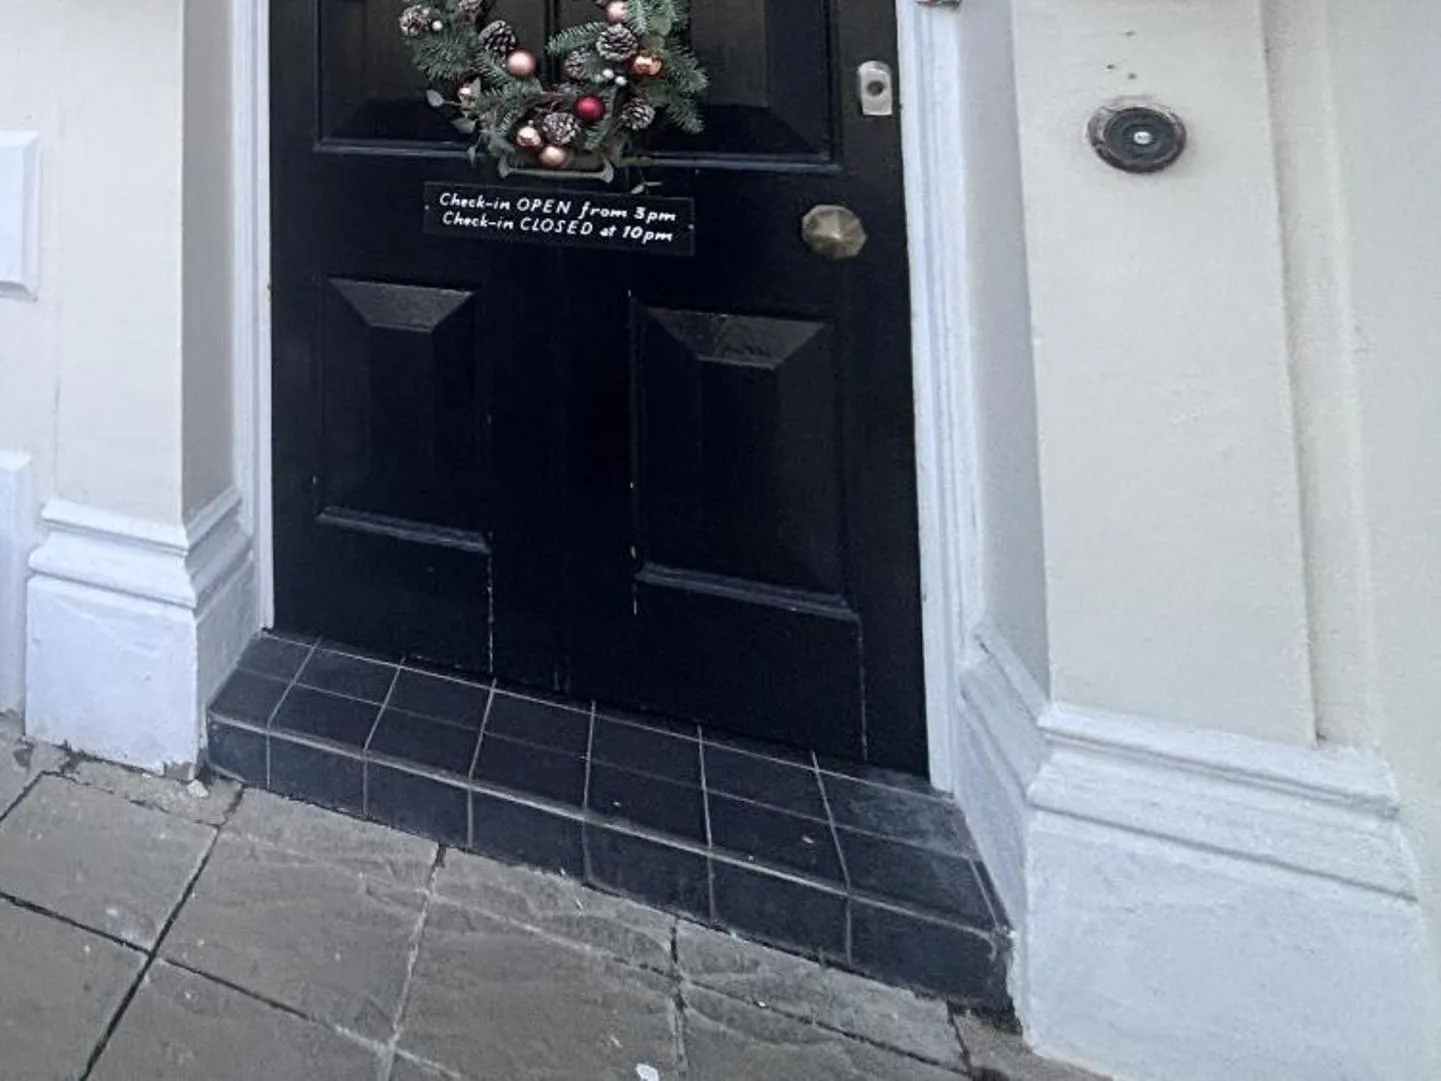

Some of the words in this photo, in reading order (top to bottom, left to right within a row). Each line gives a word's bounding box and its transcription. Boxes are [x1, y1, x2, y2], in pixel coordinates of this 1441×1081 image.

[440, 193, 510, 212] Check-in
[517, 197, 572, 215] OPEN
[579, 201, 628, 219] from
[634, 206, 676, 225] 3pm
[442, 211, 513, 230] Check-in
[520, 217, 593, 236] CLOSED
[599, 224, 618, 238] at
[623, 225, 672, 244] 10pm
